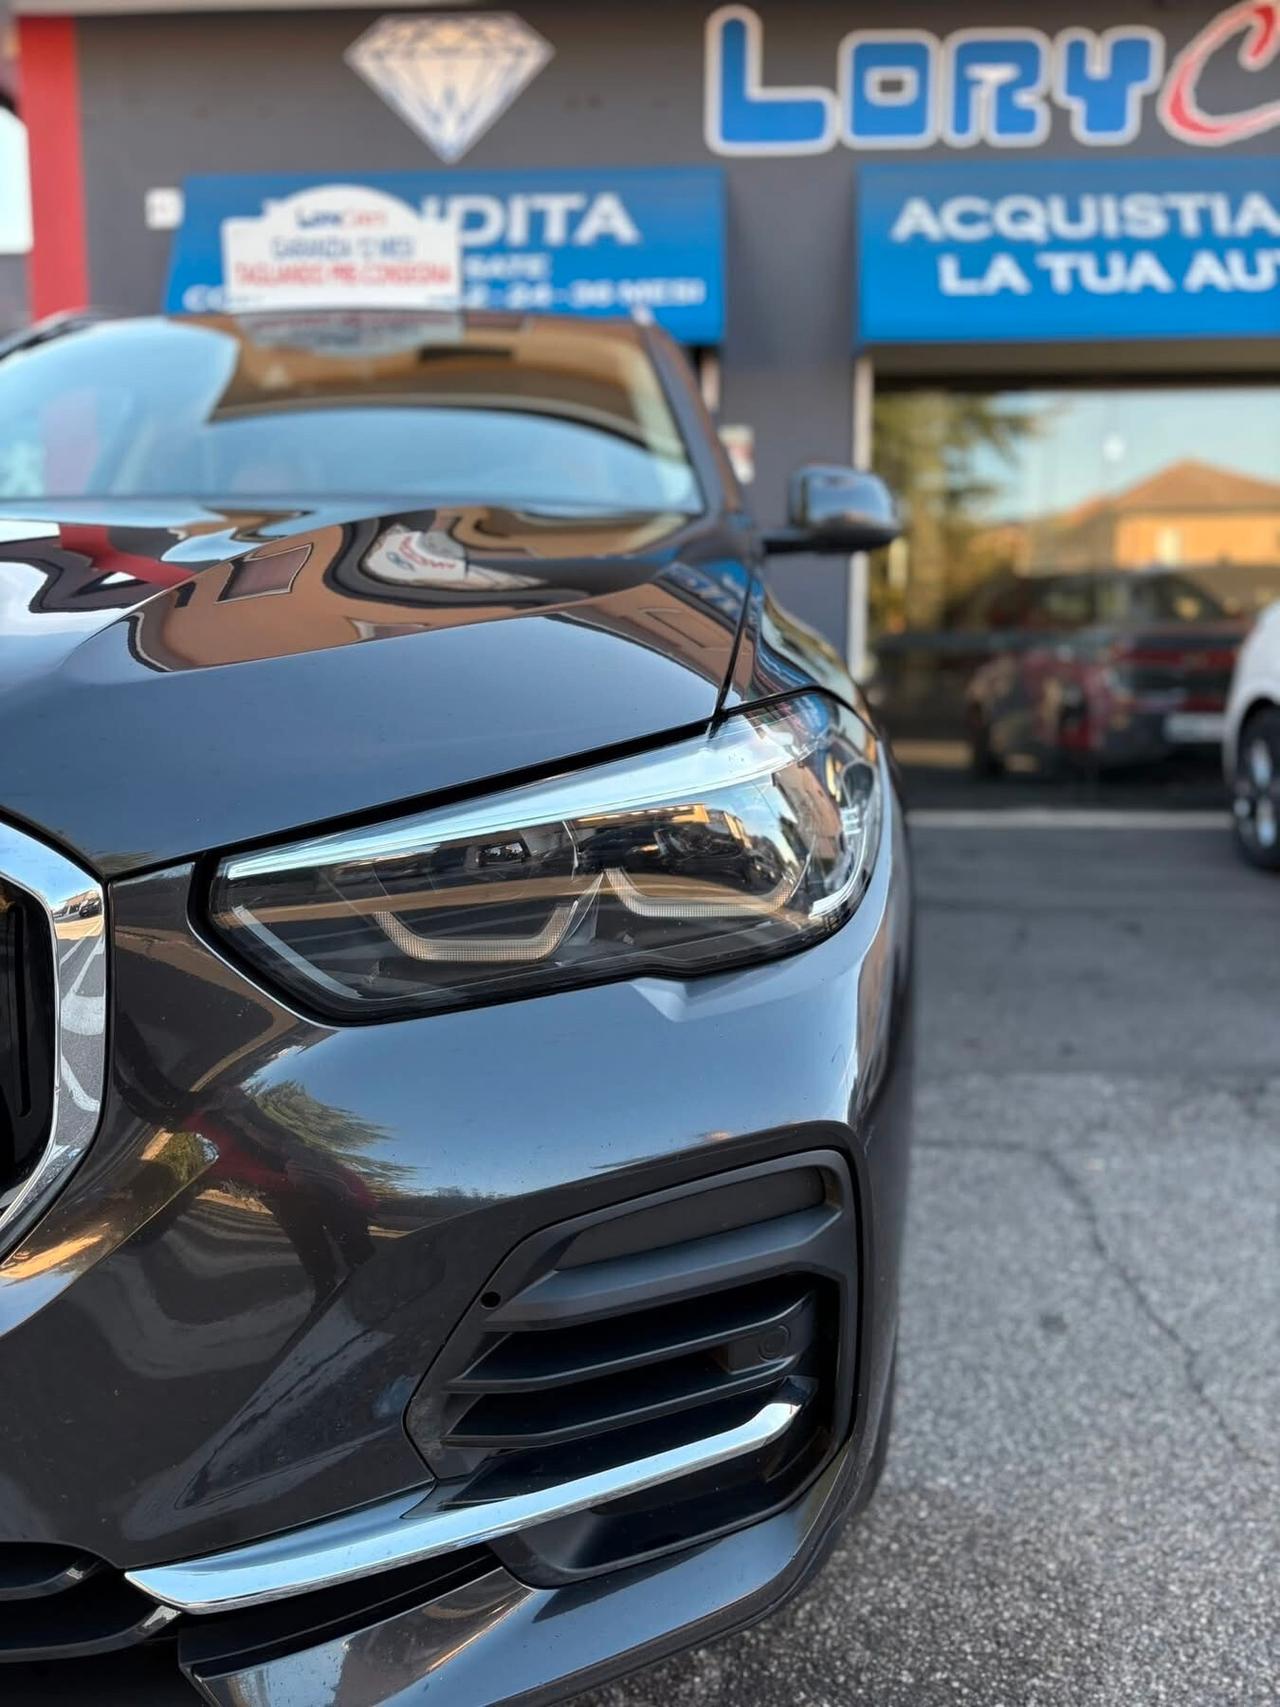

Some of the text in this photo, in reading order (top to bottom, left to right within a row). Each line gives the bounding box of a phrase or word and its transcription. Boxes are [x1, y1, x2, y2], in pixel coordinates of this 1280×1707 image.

[891, 193, 1280, 242] ACQUISTIA
[938, 254, 1031, 295] LA
[1036, 252, 1175, 294] TUA
